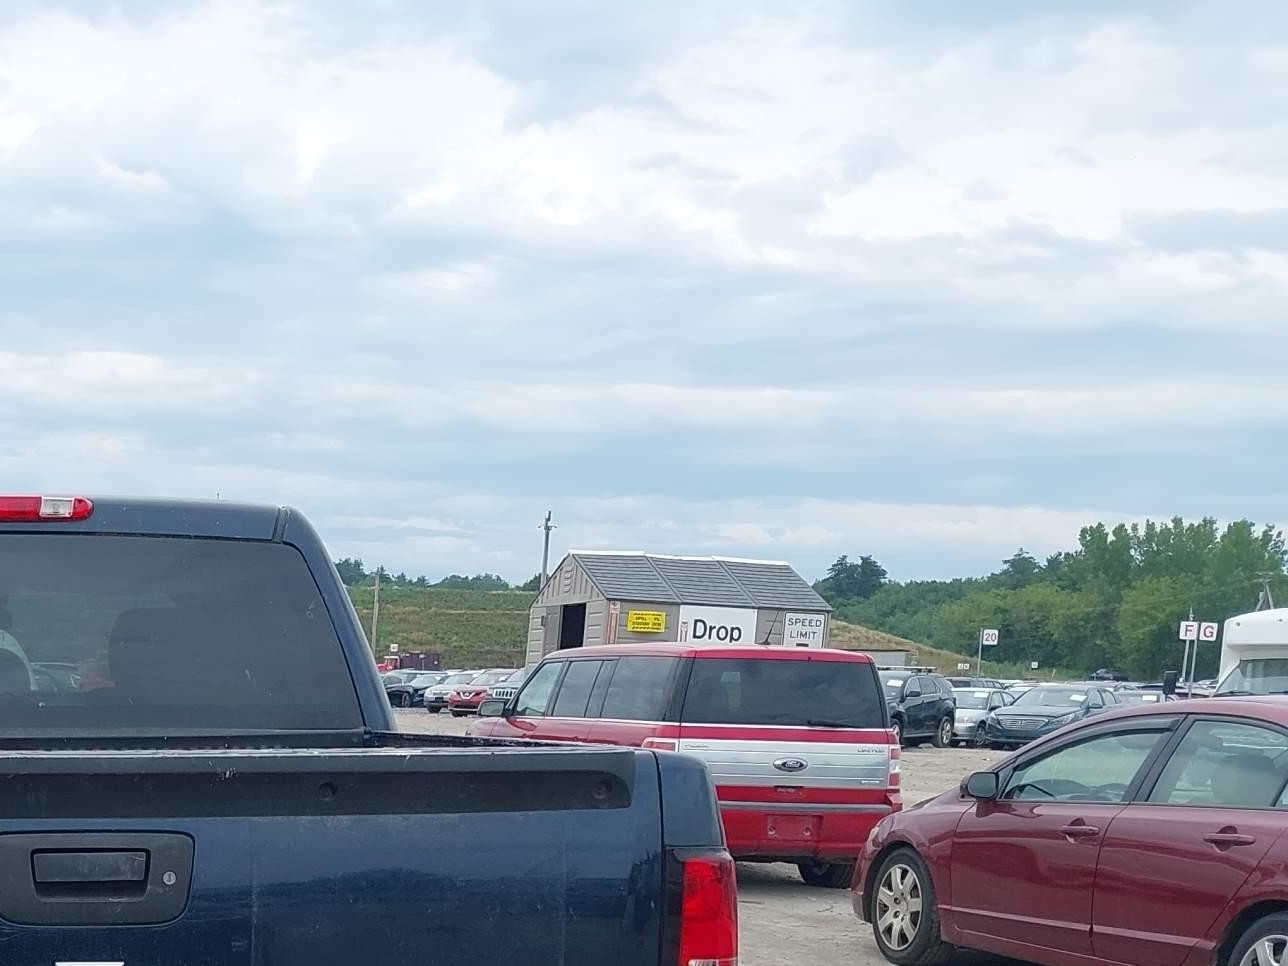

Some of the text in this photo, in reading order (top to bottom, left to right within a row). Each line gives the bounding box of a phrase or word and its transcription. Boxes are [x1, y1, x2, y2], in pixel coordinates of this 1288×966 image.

[787, 617, 823, 628] SPEED
[692, 618, 743, 643] Drop
[789, 631, 819, 641] LIMIT
[1184, 624, 1195, 638] F
[1203, 625, 1215, 639] G
[984, 632, 997, 642] 20
